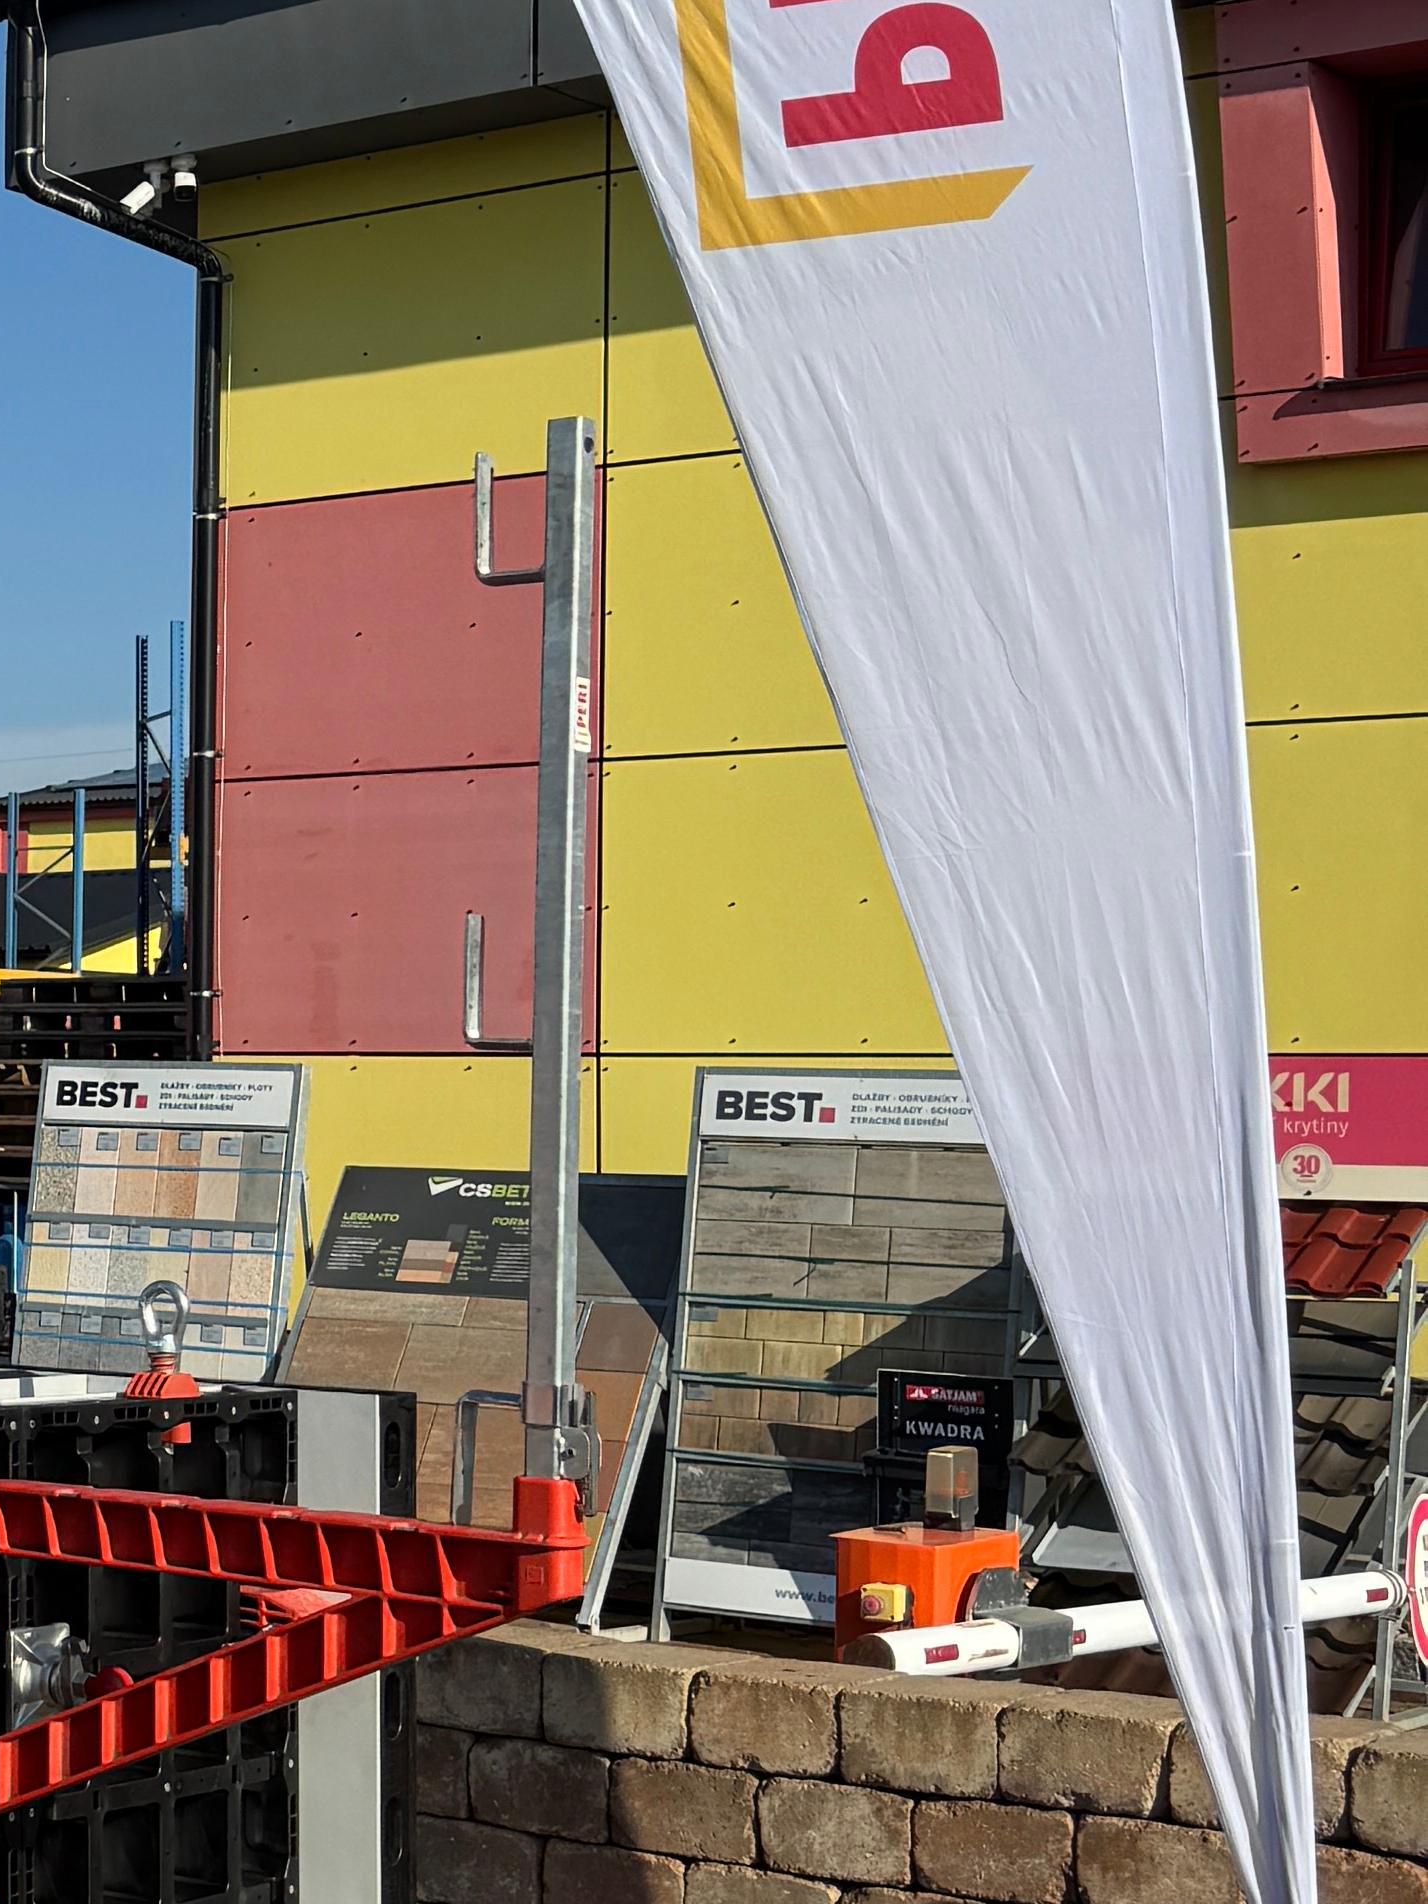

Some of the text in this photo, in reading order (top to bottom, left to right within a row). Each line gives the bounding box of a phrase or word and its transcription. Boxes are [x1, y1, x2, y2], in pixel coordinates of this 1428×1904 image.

[576, 684, 587, 728] PERI
[1283, 1117, 1349, 1138] krytiny
[1292, 1154, 1321, 1175] 30
[905, 1420, 985, 1441] KWADRA
